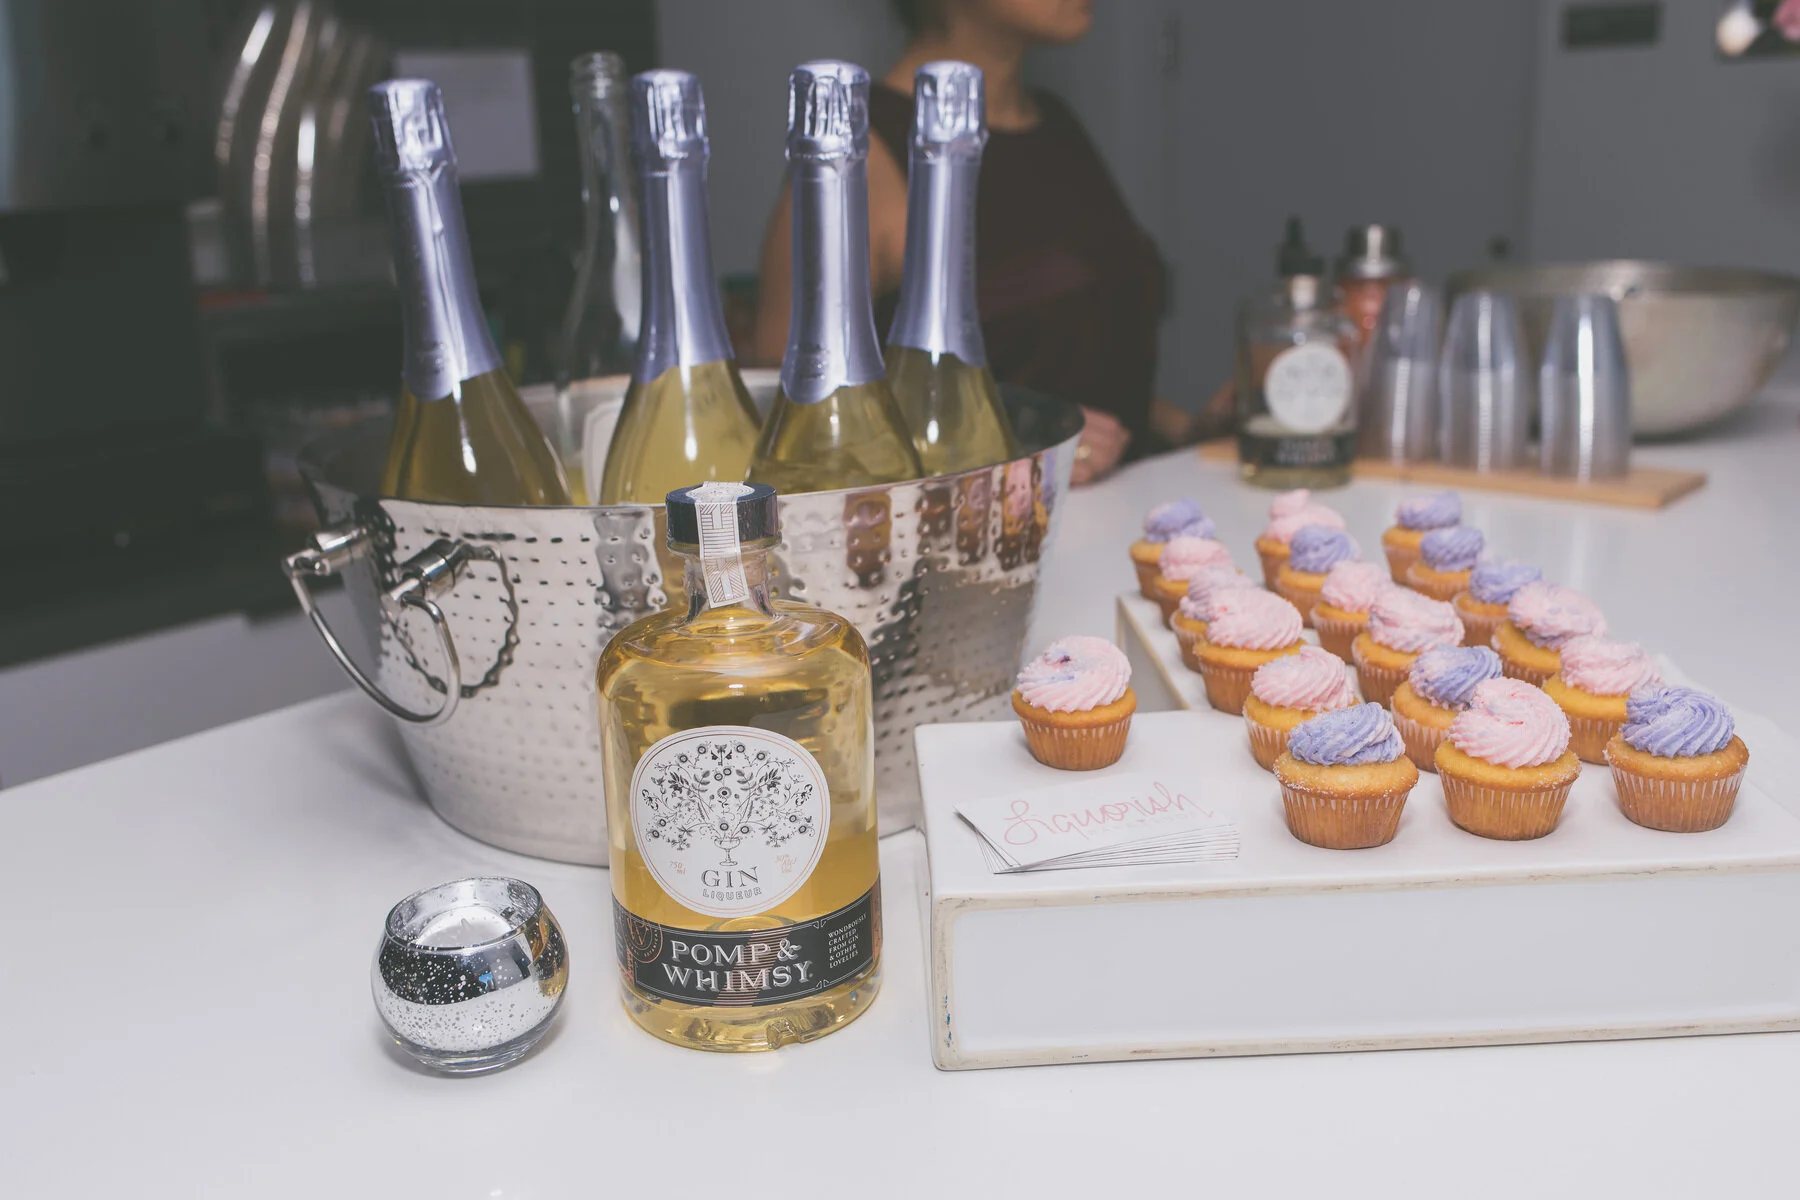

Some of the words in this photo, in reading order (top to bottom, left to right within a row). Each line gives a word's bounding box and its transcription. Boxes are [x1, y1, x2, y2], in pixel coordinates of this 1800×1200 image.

[701, 866, 759, 888] GIN
[702, 887, 762, 901] LIQUEUR
[828, 928, 857, 946] CRAFTED
[828, 942, 847, 954] FROM
[847, 934, 859, 945] GIN
[671, 939, 773, 966] POMP
[776, 937, 803, 962] &
[829, 949, 859, 969] LOVELIES
[835, 943, 857, 958] OTHER
